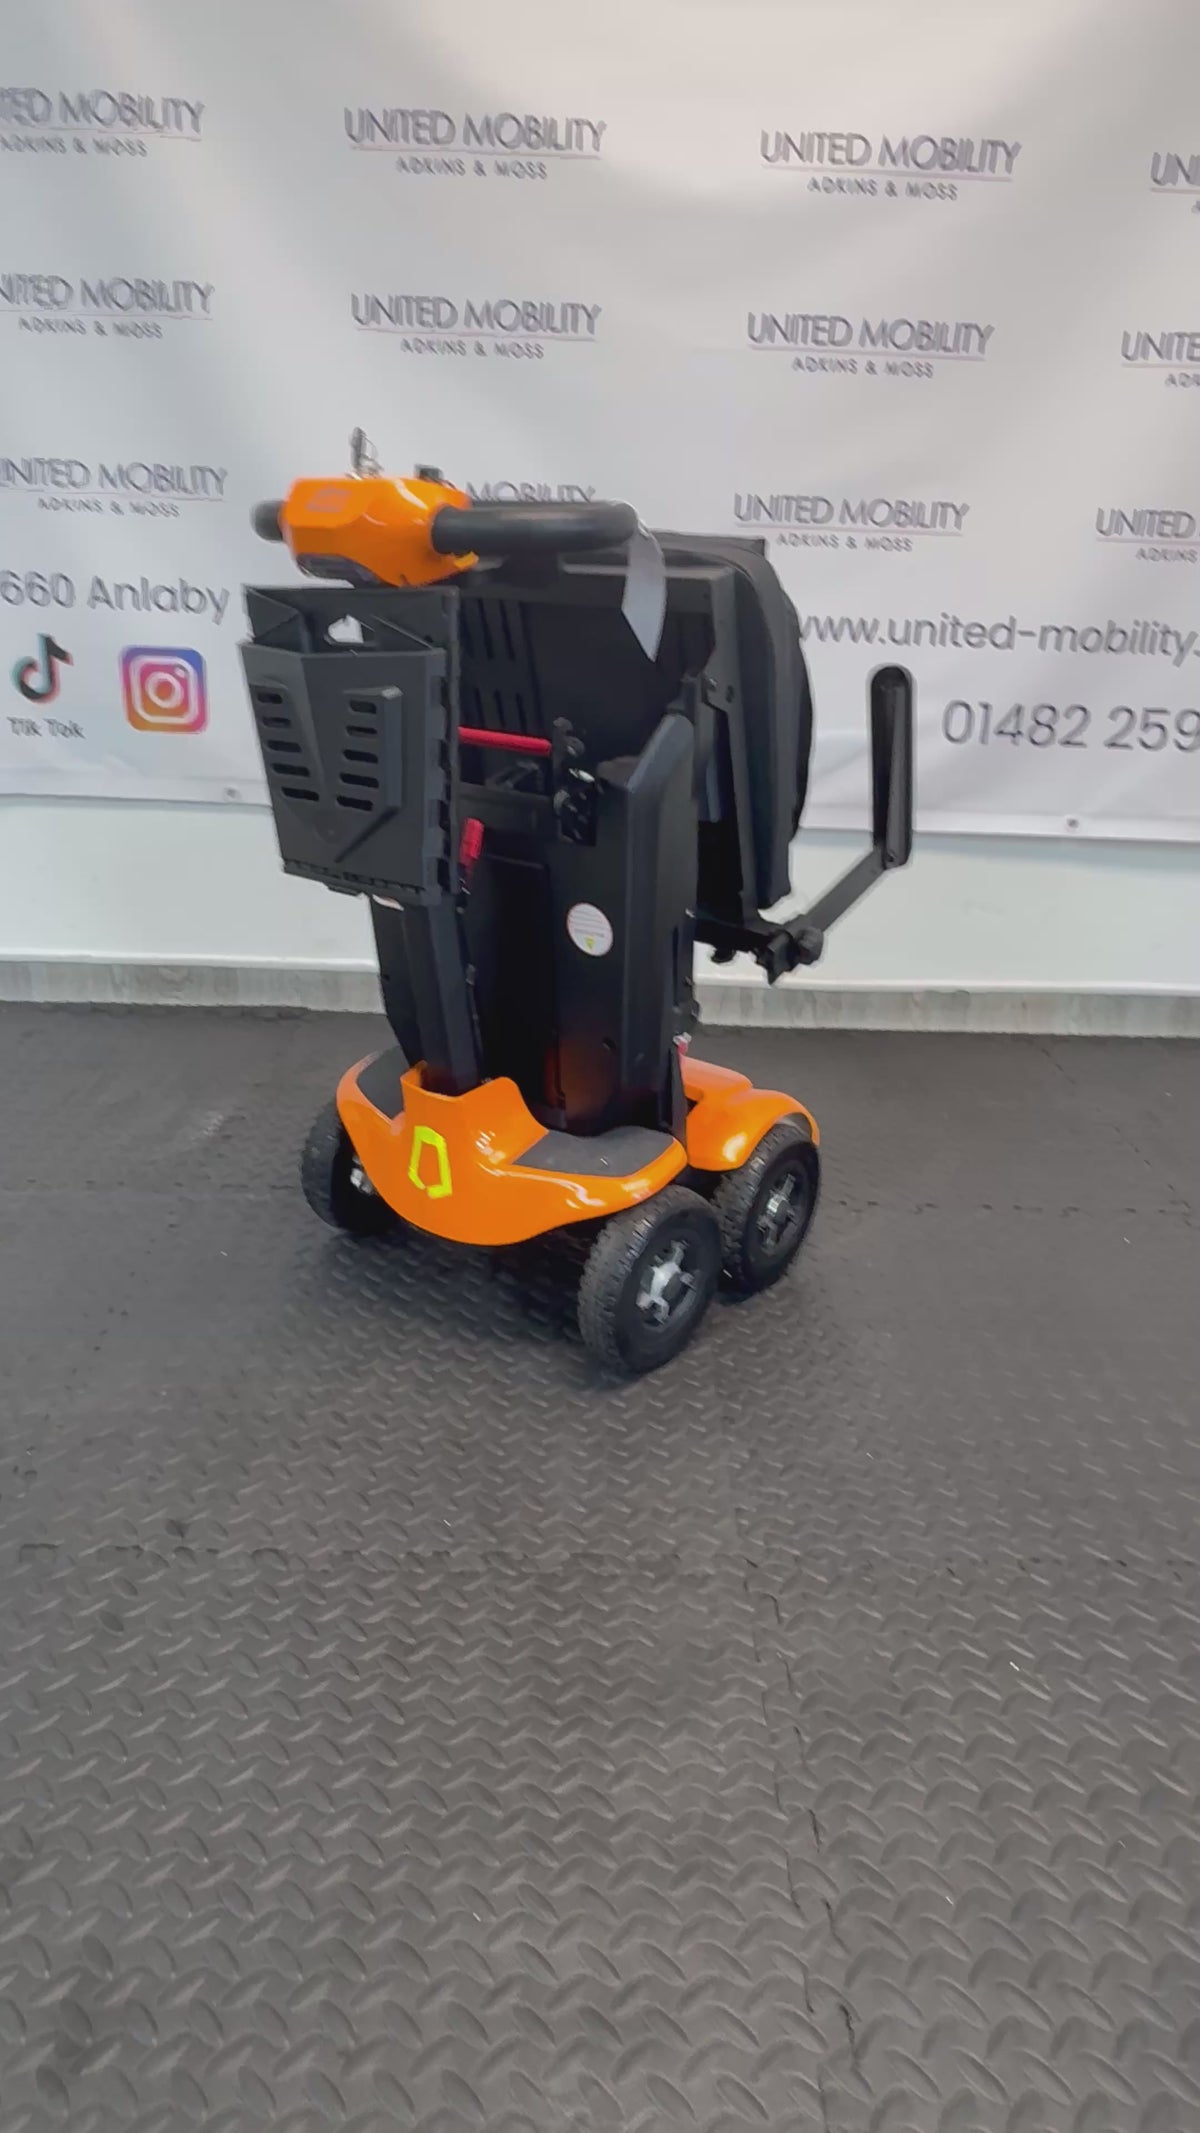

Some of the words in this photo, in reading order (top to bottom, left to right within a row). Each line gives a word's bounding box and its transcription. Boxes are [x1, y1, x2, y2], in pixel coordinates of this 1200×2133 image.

[58, 88, 206, 134] MOBILITY
[344, 107, 456, 146] UNITED
[462, 112, 607, 152] MOBILITY
[396, 155, 466, 176] ADKINS
[473, 158, 487, 176] &
[495, 159, 548, 180] MOSS
[761, 130, 872, 166] UNITED
[878, 134, 1022, 174] MOBILITY
[807, 177, 878, 197] ADKINS
[885, 180, 898, 198] &
[905, 180, 958, 201] MOSS
[79, 276, 216, 314] MOBILITY
[351, 293, 458, 330] UNITED
[463, 298, 602, 335] MOBILITY
[401, 337, 467, 357] ADKINS
[474, 341, 488, 358] &
[494, 341, 545, 360] MOSS
[747, 312, 853, 348] UNITED
[858, 317, 995, 355] MOBILITY
[792, 357, 858, 376] ADKINS
[865, 360, 878, 376] &
[884, 360, 934, 379] MOSS
[98, 462, 228, 496] MOBILITY
[734, 493, 834, 525] UNITED
[839, 498, 970, 532] MOBILITY
[1095, 507, 1196, 539] UNITED
[776, 532, 840, 549] ADKINS
[845, 535, 857, 550] &
[864, 535, 913, 553] MOSS
[1135, 547, 1198, 564] ADKINS
[86, 574, 230, 626] Anlaby
[942, 699, 1092, 750] 01482
[1103, 705, 1200, 753] 259
